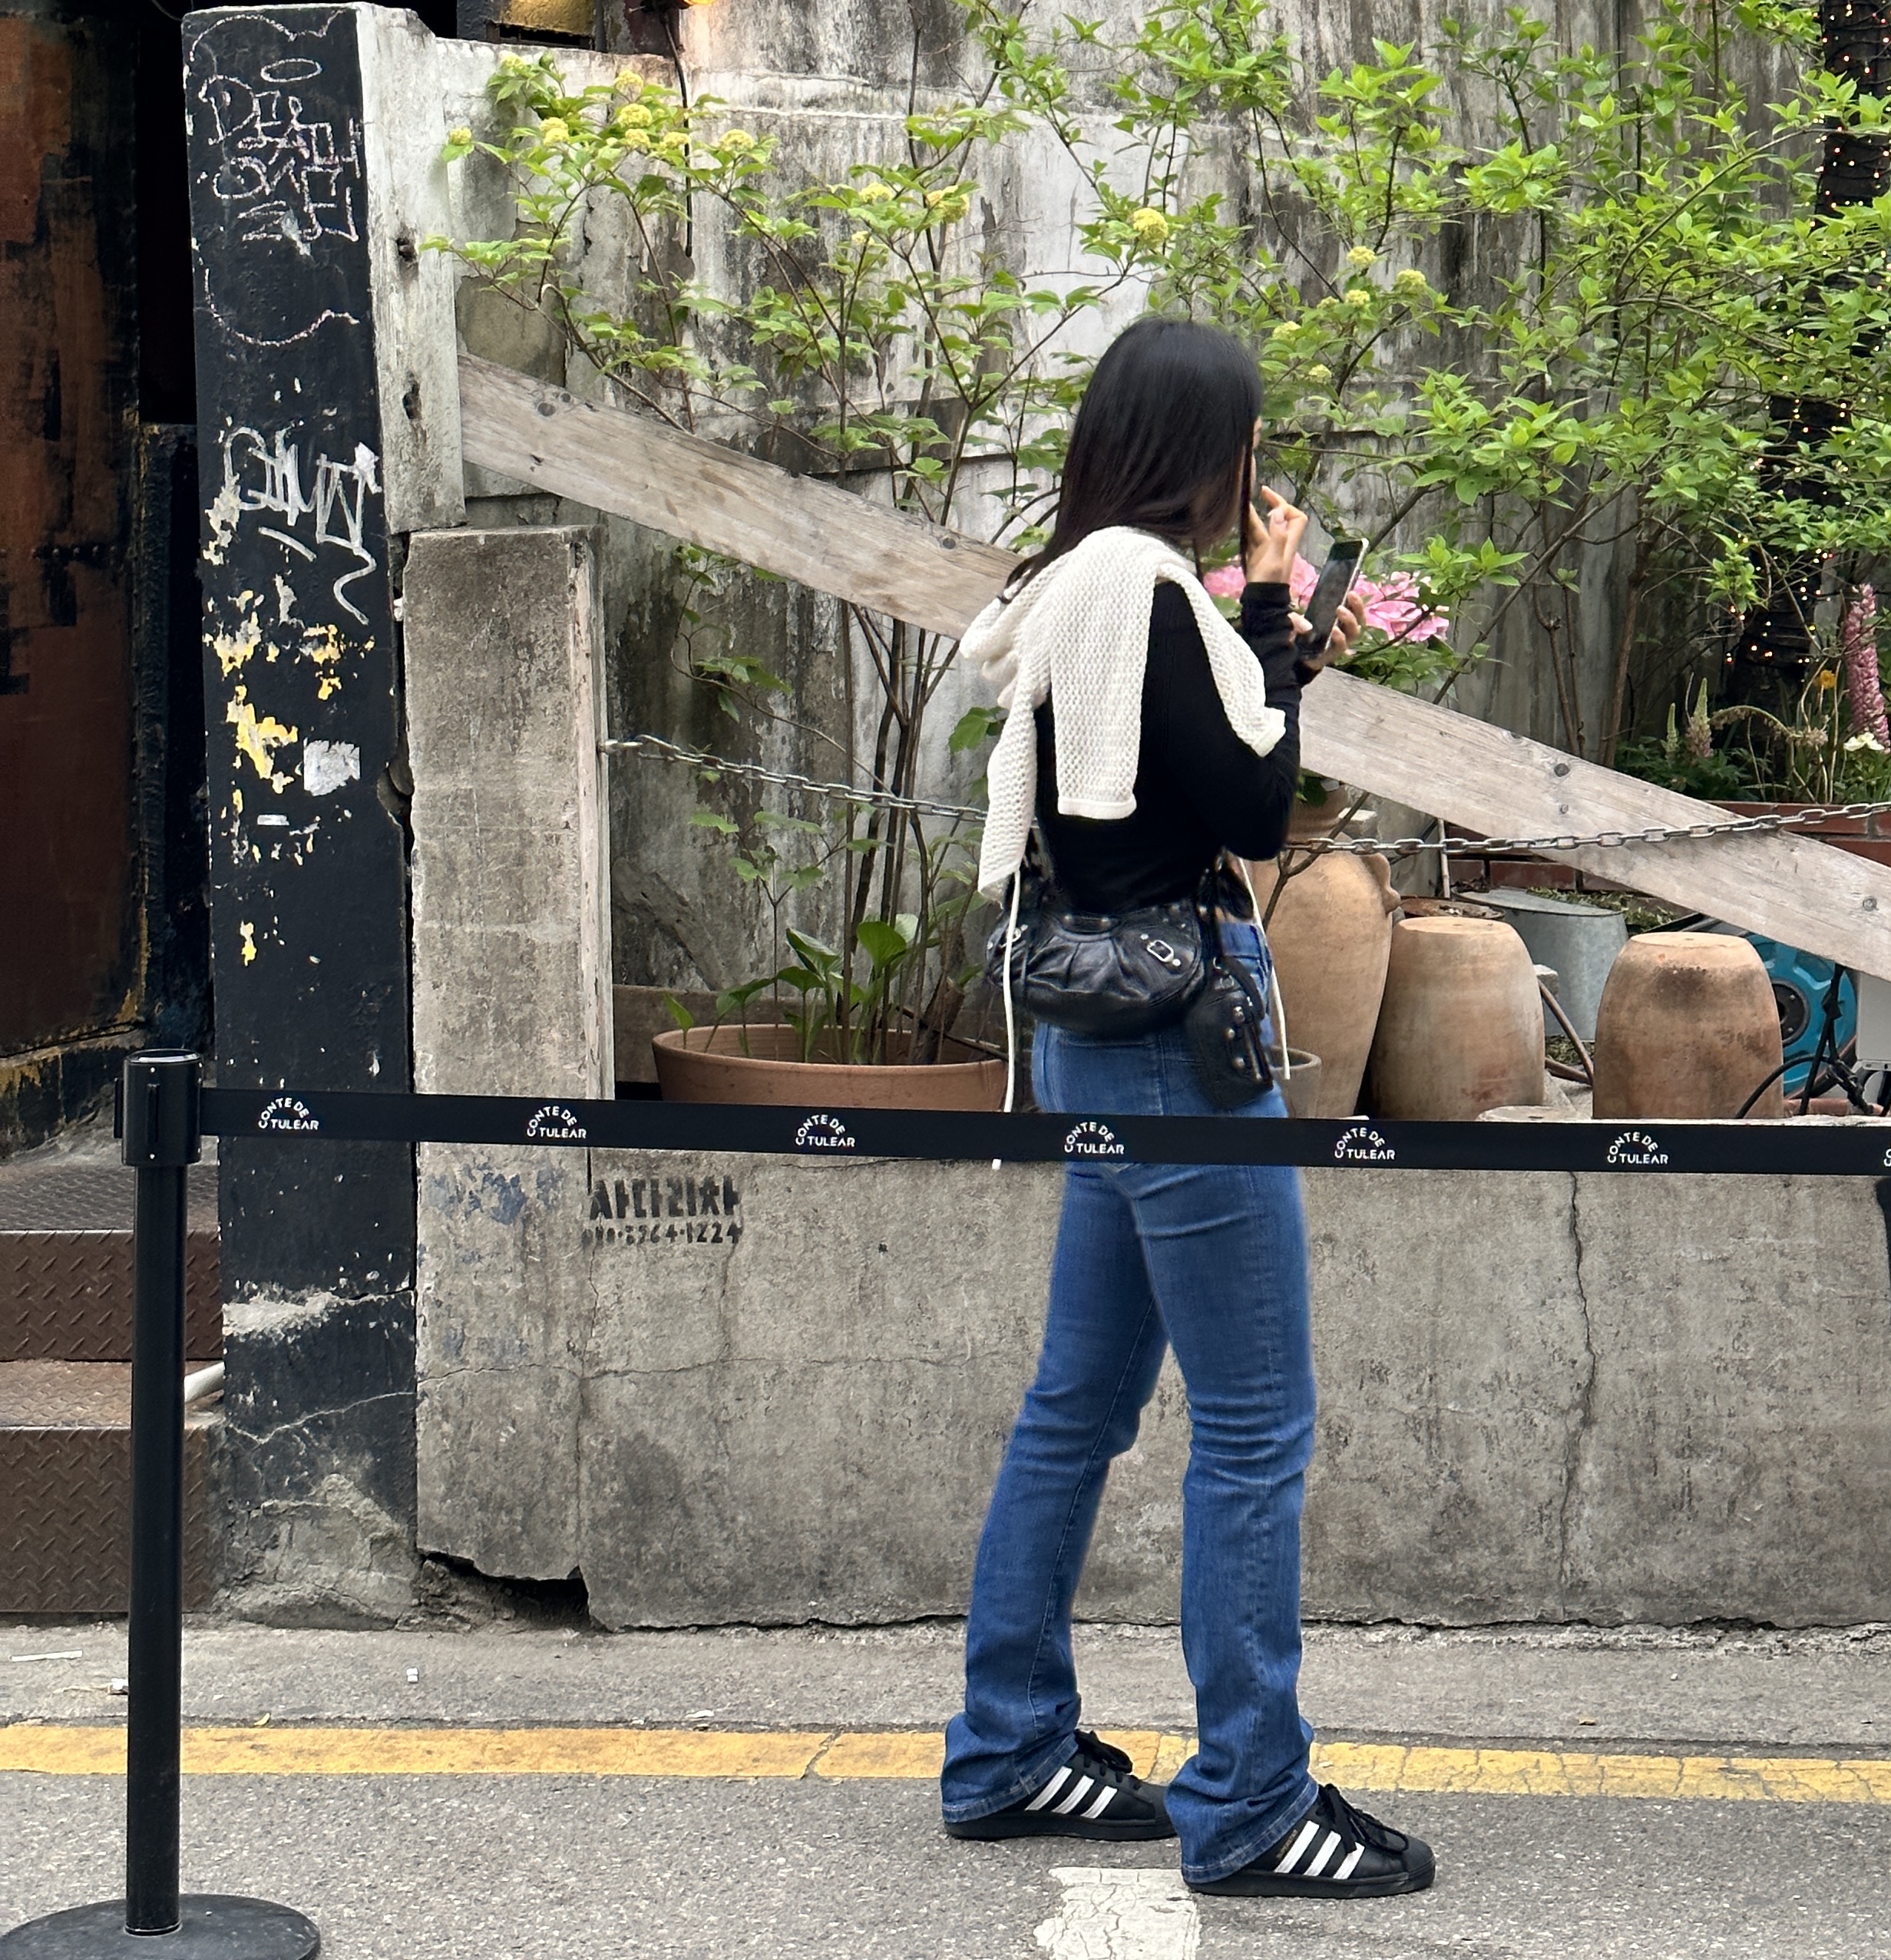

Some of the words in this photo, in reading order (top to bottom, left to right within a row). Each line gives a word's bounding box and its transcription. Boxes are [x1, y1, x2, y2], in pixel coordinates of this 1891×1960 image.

[258, 1098, 293, 1129] CONTE
[293, 1101, 309, 1118] DE
[527, 1106, 560, 1137] CONTE
[561, 1109, 577, 1125] DE
[271, 1119, 319, 1130] TULEAR
[540, 1127, 587, 1139] TULEAR
[795, 1115, 828, 1146] CONTE
[829, 1119, 845, 1135] DE
[807, 1136, 855, 1147] TULEAR
[1065, 1122, 1097, 1153] CONTE
[1099, 1125, 1114, 1142] DE
[1335, 1128, 1367, 1158] CONTE
[1369, 1131, 1384, 1147] DE
[1607, 1132, 1641, 1164] CONTE
[1641, 1135, 1658, 1152] DE
[1076, 1143, 1124, 1154] TULEAR
[1347, 1149, 1395, 1160] TULEAR
[1619, 1154, 1668, 1165] TULEAR
